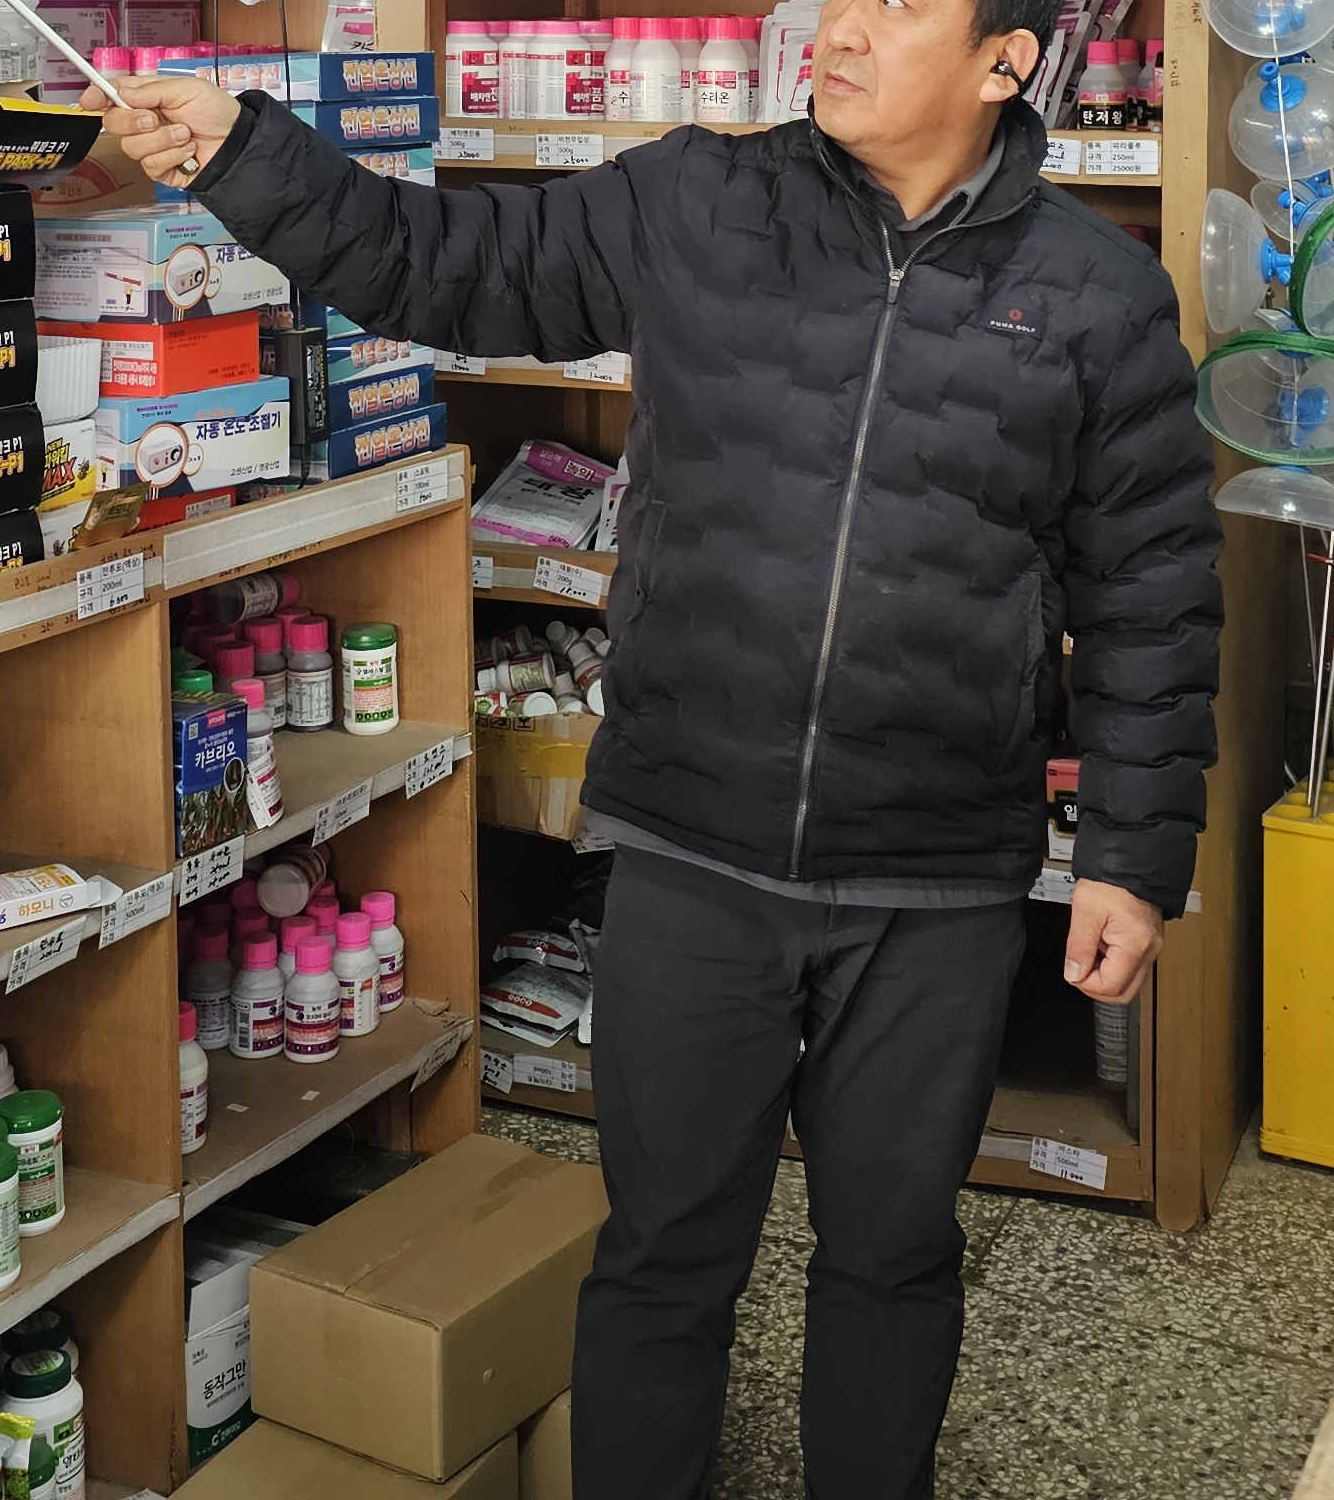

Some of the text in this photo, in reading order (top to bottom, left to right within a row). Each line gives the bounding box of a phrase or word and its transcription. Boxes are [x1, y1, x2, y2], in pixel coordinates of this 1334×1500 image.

[343, 59, 417, 91] 전열온상선
[701, 91, 730, 104] 수리온
[340, 104, 420, 139] 전열온상선
[1083, 109, 1123, 125] 탄저왕
[1, 153, 64, 170] PARK-P1
[558, 147, 573, 155] 500g
[1113, 153, 1134, 161] 250ml
[1113, 164, 1141, 173] 25000원
[349, 374, 420, 419] 전열온상선
[196, 411, 282, 441] 자동 온도 조절기
[354, 420, 430, 466] 전열온상선
[195, 741, 236, 769] 카브리오
[18, 899, 54, 918] 하모니
[203, 1359, 248, 1400] 동작그만
